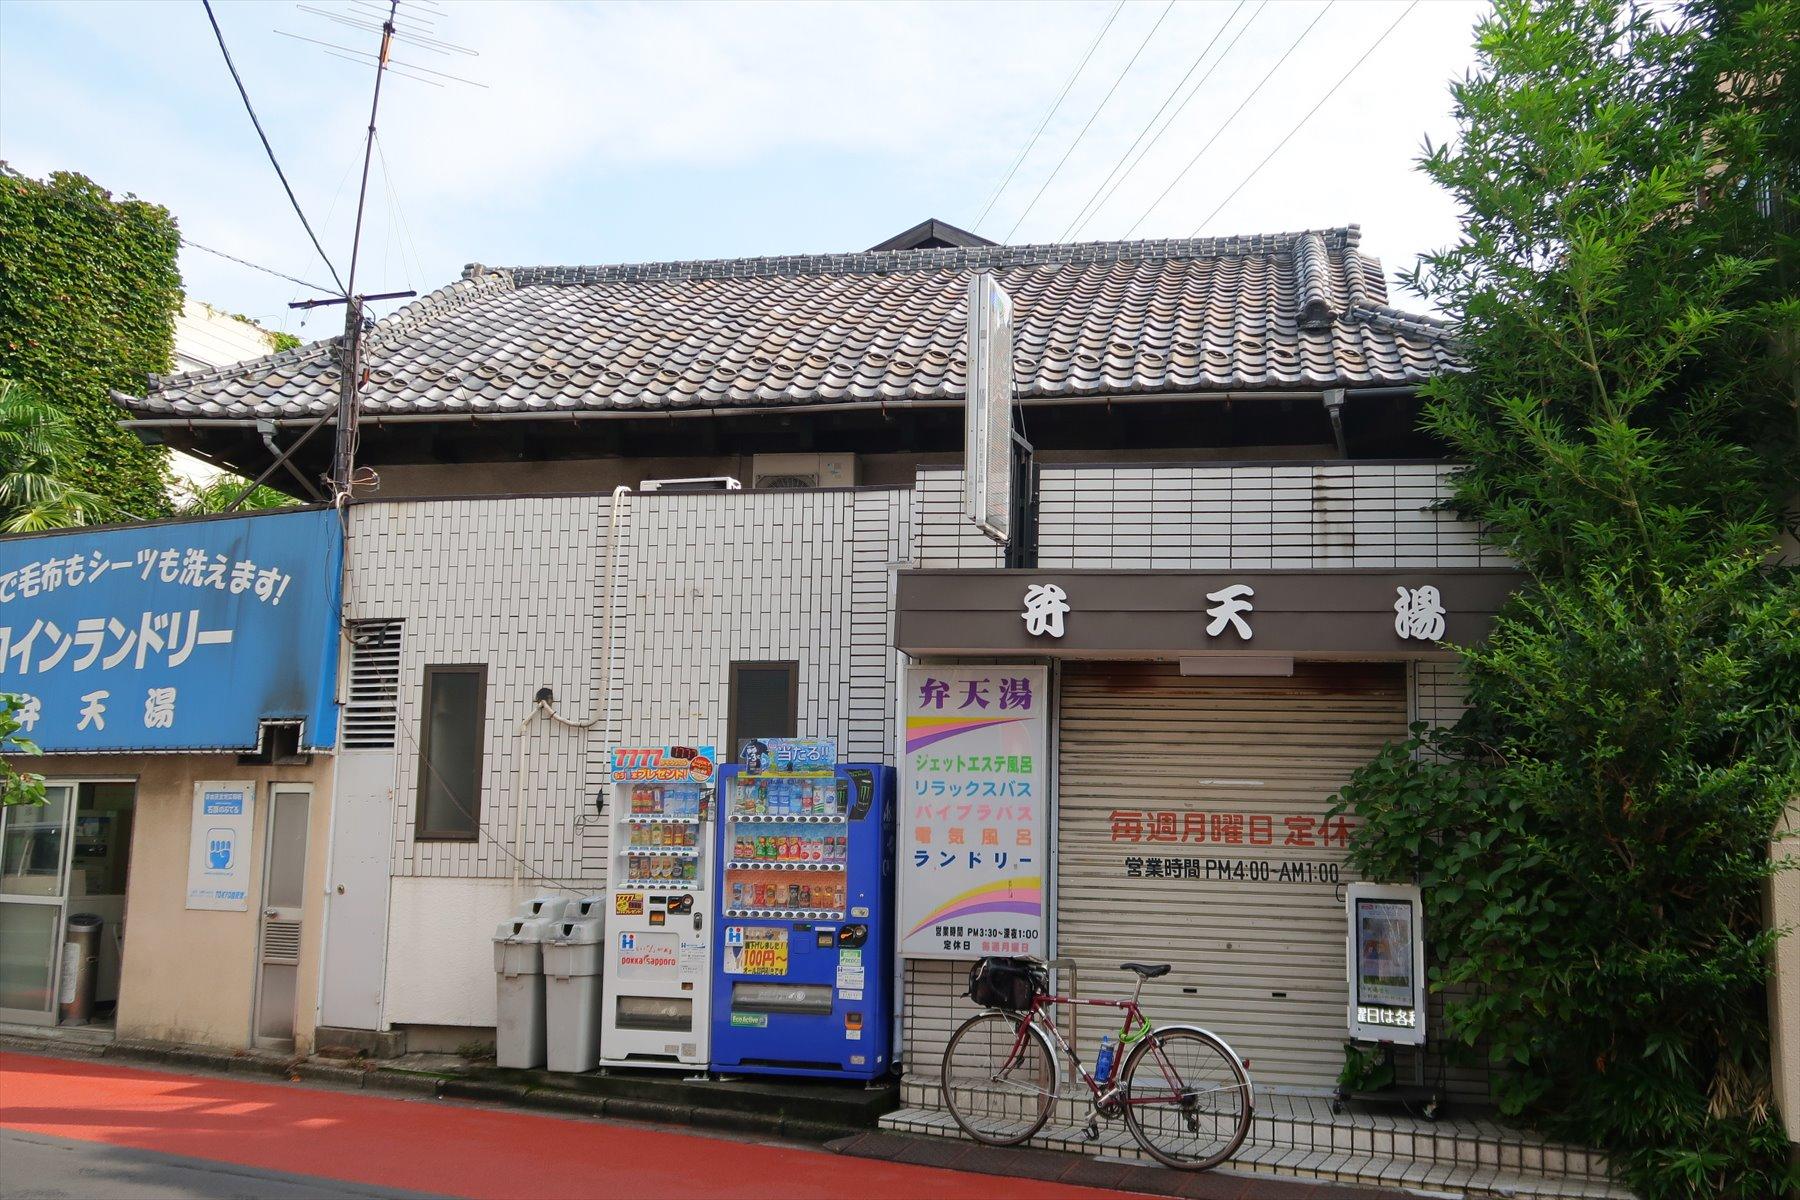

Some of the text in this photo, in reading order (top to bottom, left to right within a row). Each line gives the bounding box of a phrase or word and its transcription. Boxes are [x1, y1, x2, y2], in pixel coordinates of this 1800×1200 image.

[1021, 584, 1446, 641] 弁天湯
[919, 678, 1032, 710] 弁天湯
[916, 754, 1032, 774] ジェットエステ風呂
[915, 779, 1032, 797] リラックスバス
[915, 827, 1032, 846] 電気風呂
[914, 850, 1032, 869] ランドリー
[943, 940, 971, 951] 定休日
